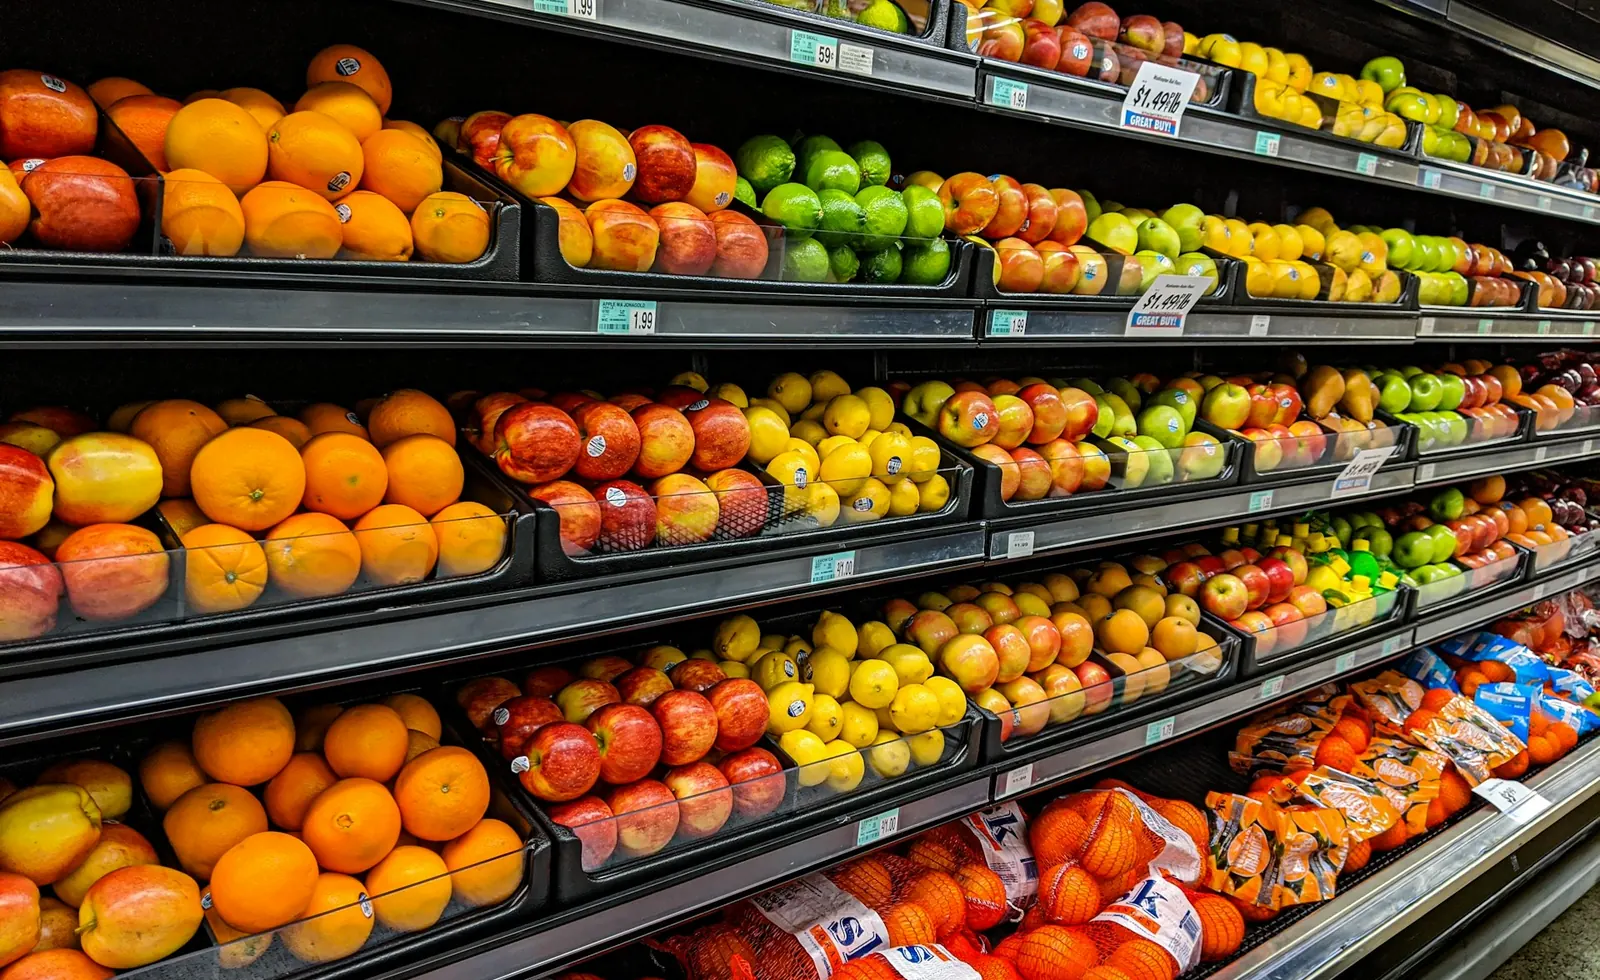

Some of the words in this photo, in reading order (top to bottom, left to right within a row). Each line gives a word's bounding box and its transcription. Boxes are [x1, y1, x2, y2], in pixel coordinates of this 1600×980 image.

[574, 0, 593, 16] 1.99
[818, 46, 834, 64] 59¢
[1013, 91, 1025, 108] 1.99
[1133, 84, 1169, 111] $1.49
[1130, 114, 1153, 129] GREAT
[1153, 120, 1172, 133] BUY!
[1142, 292, 1179, 310] $1.49
[634, 311, 653, 330] 1.99
[1013, 318, 1024, 333] 1.99
[1136, 315, 1160, 326] GREAT
[1160, 315, 1177, 327] BUY!
